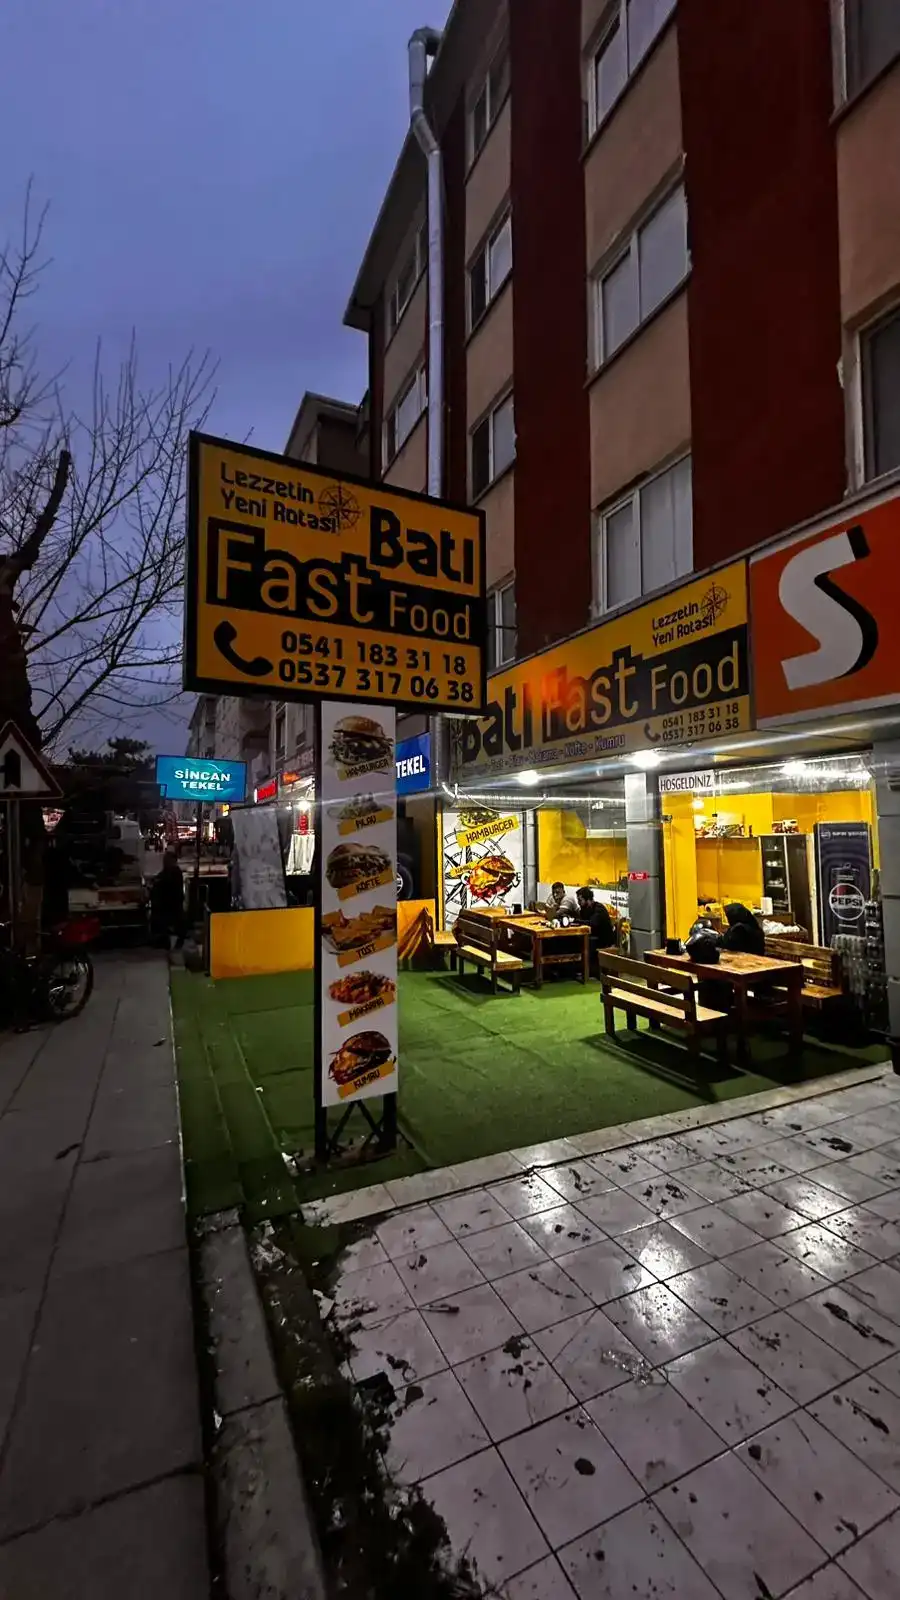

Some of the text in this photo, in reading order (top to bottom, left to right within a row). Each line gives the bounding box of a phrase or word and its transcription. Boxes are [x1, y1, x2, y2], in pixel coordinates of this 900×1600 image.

[220, 462, 314, 504] Lezzetin
[221, 489, 337, 533] Yeni Rotası
[370, 505, 474, 585] Batı
[214, 525, 471, 640] Fast Food
[652, 602, 698, 630] Lezzetin
[653, 628, 674, 647] Yeni
[281, 630, 466, 676] 0541 183 31 18
[279, 659, 474, 702] 0537 317 06 38
[651, 640, 739, 710] Food
[663, 703, 739, 729] 0541 183 31 18
[662, 717, 739, 741] 0537 317 06 38
[174, 768, 231, 782] SİNCAN
[345, 758, 389, 777] HAMBURGER
[395, 754, 426, 779] TEKEL
[180, 780, 224, 791] TEKEL
[465, 819, 514, 843] HAMBURGER
[831, 896, 863, 907] PEPSI
[355, 943, 376, 960] TOST
[353, 1069, 380, 1089] KUMRU
